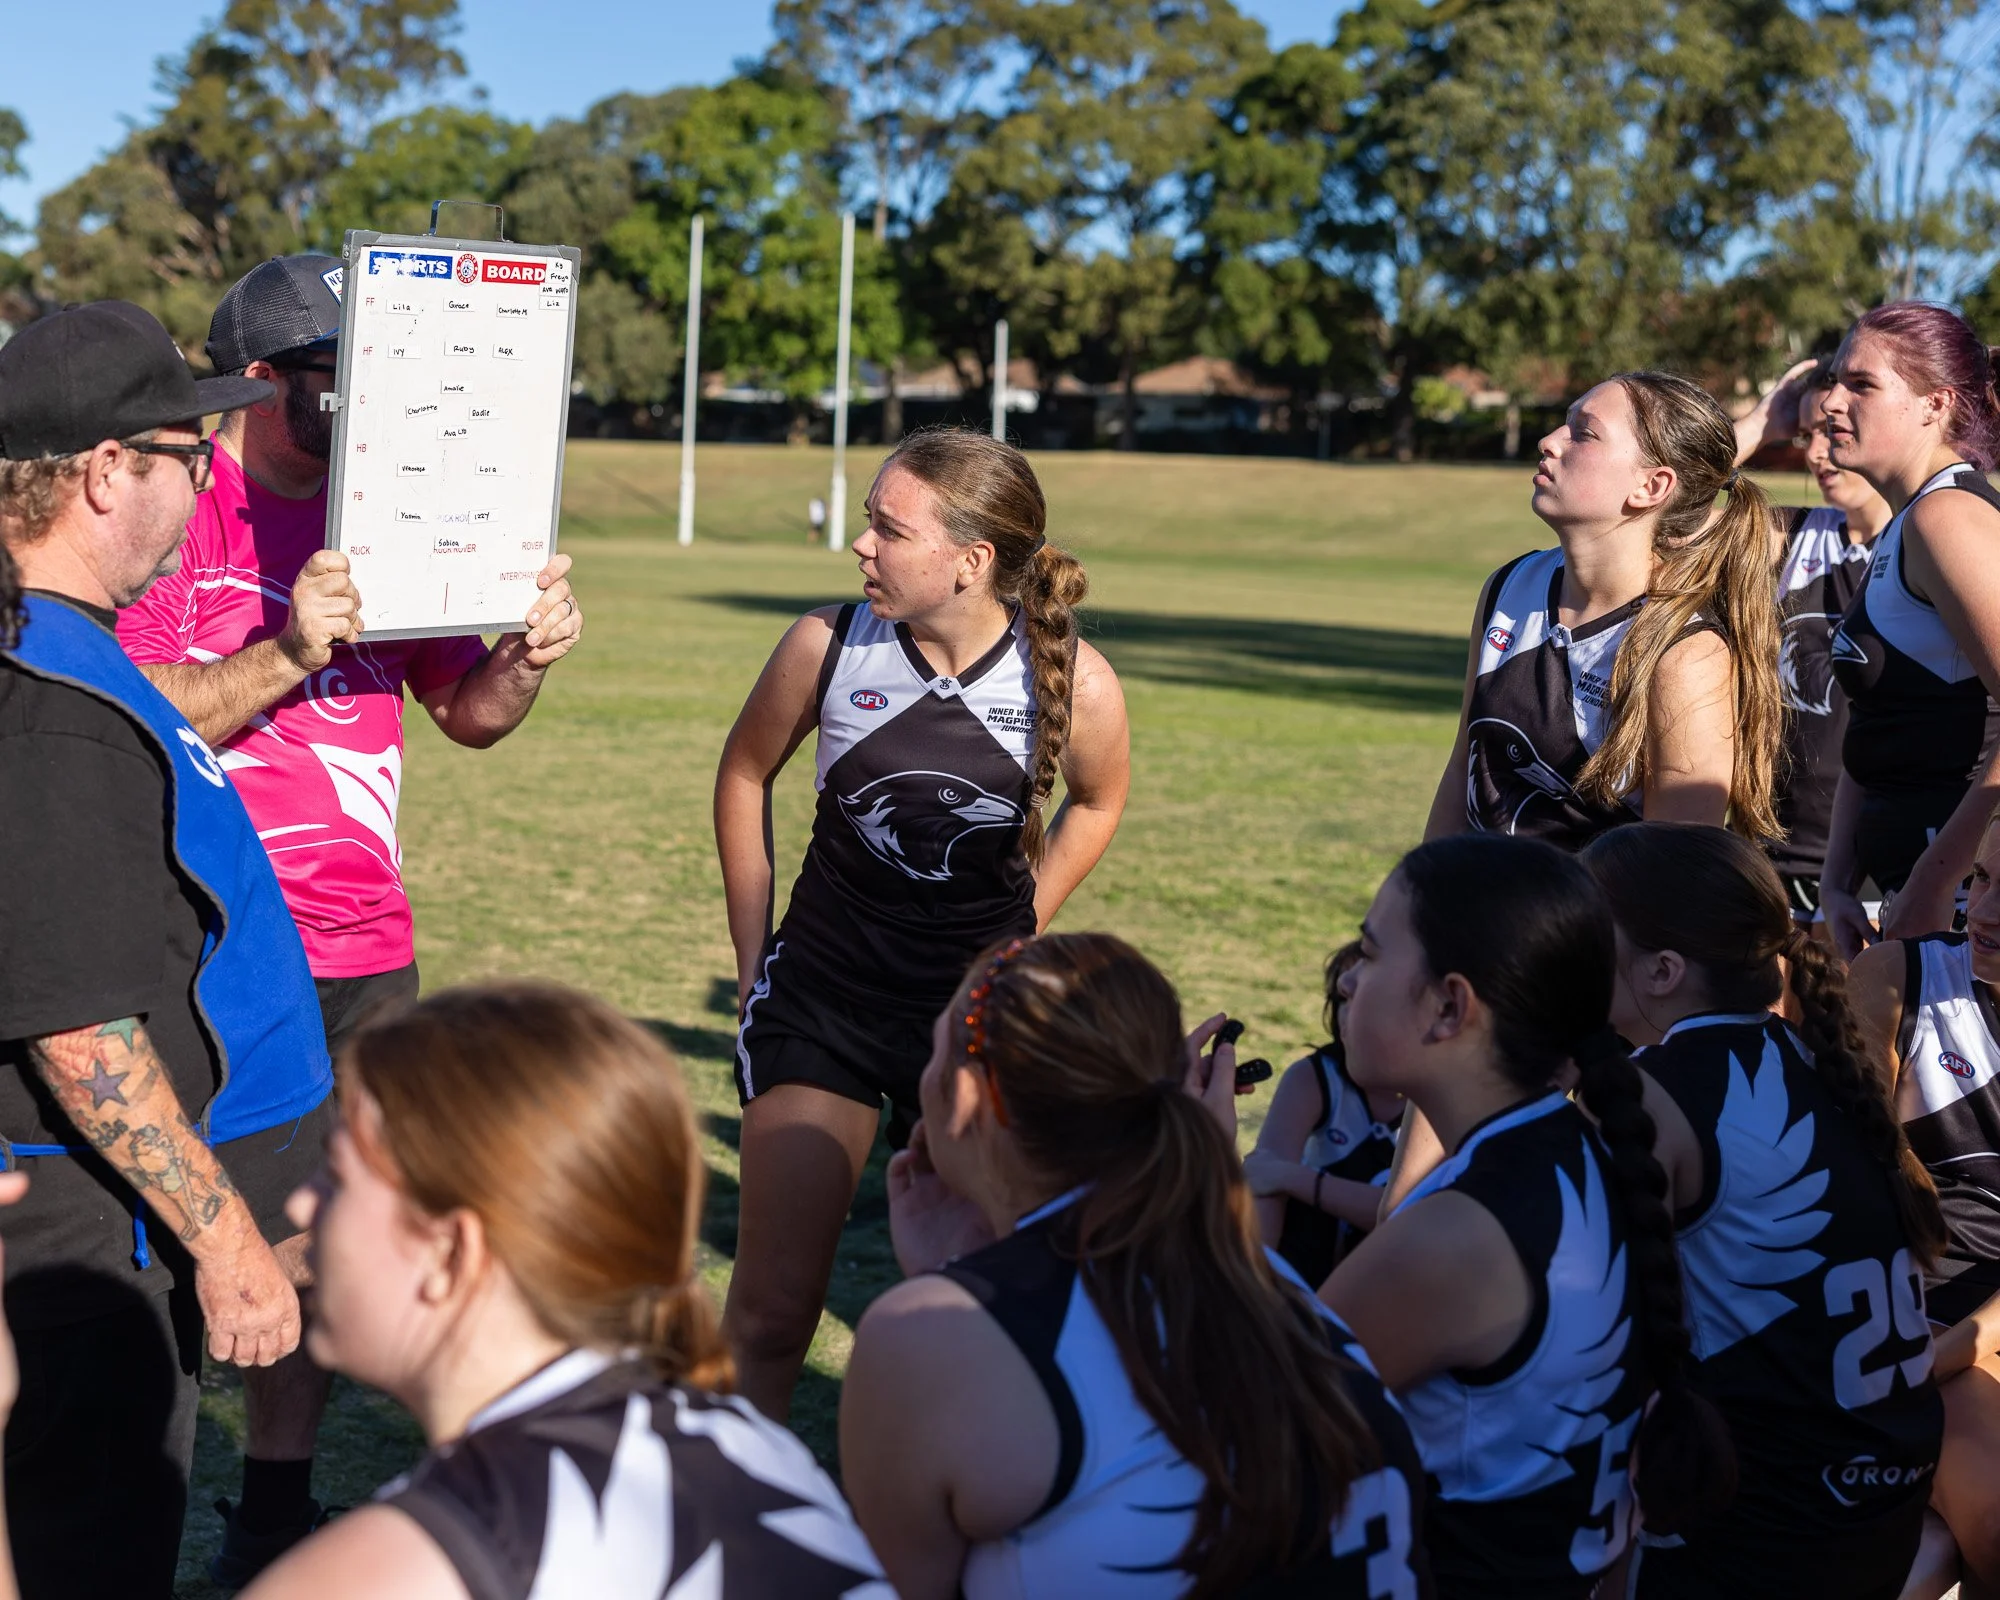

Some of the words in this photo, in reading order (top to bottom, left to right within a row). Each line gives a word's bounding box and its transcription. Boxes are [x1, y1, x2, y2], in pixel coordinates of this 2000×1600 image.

[486, 264, 546, 282] BOARD
[365, 297, 375, 306] FF
[448, 300, 469, 309] Grace
[362, 346, 373, 356] HF
[359, 394, 366, 405] C
[407, 405, 438, 415] Charlotte
[356, 443, 367, 453] HB
[353, 491, 364, 501] FB
[349, 545, 371, 556] RUCK
[521, 541, 544, 551] ROVER
[1487, 630, 1512, 650] AFL
[1576, 679, 1609, 699] MAGPIE
[853, 694, 885, 707] AFL
[988, 707, 1015, 716] INNER
[986, 714, 1037, 728] MAGPIES
[1000, 725, 1035, 735] JUNIORS
[1940, 1055, 1971, 1077] AFL
[1823, 1248, 1936, 1410] 29
[1568, 1404, 1639, 1576] 5
